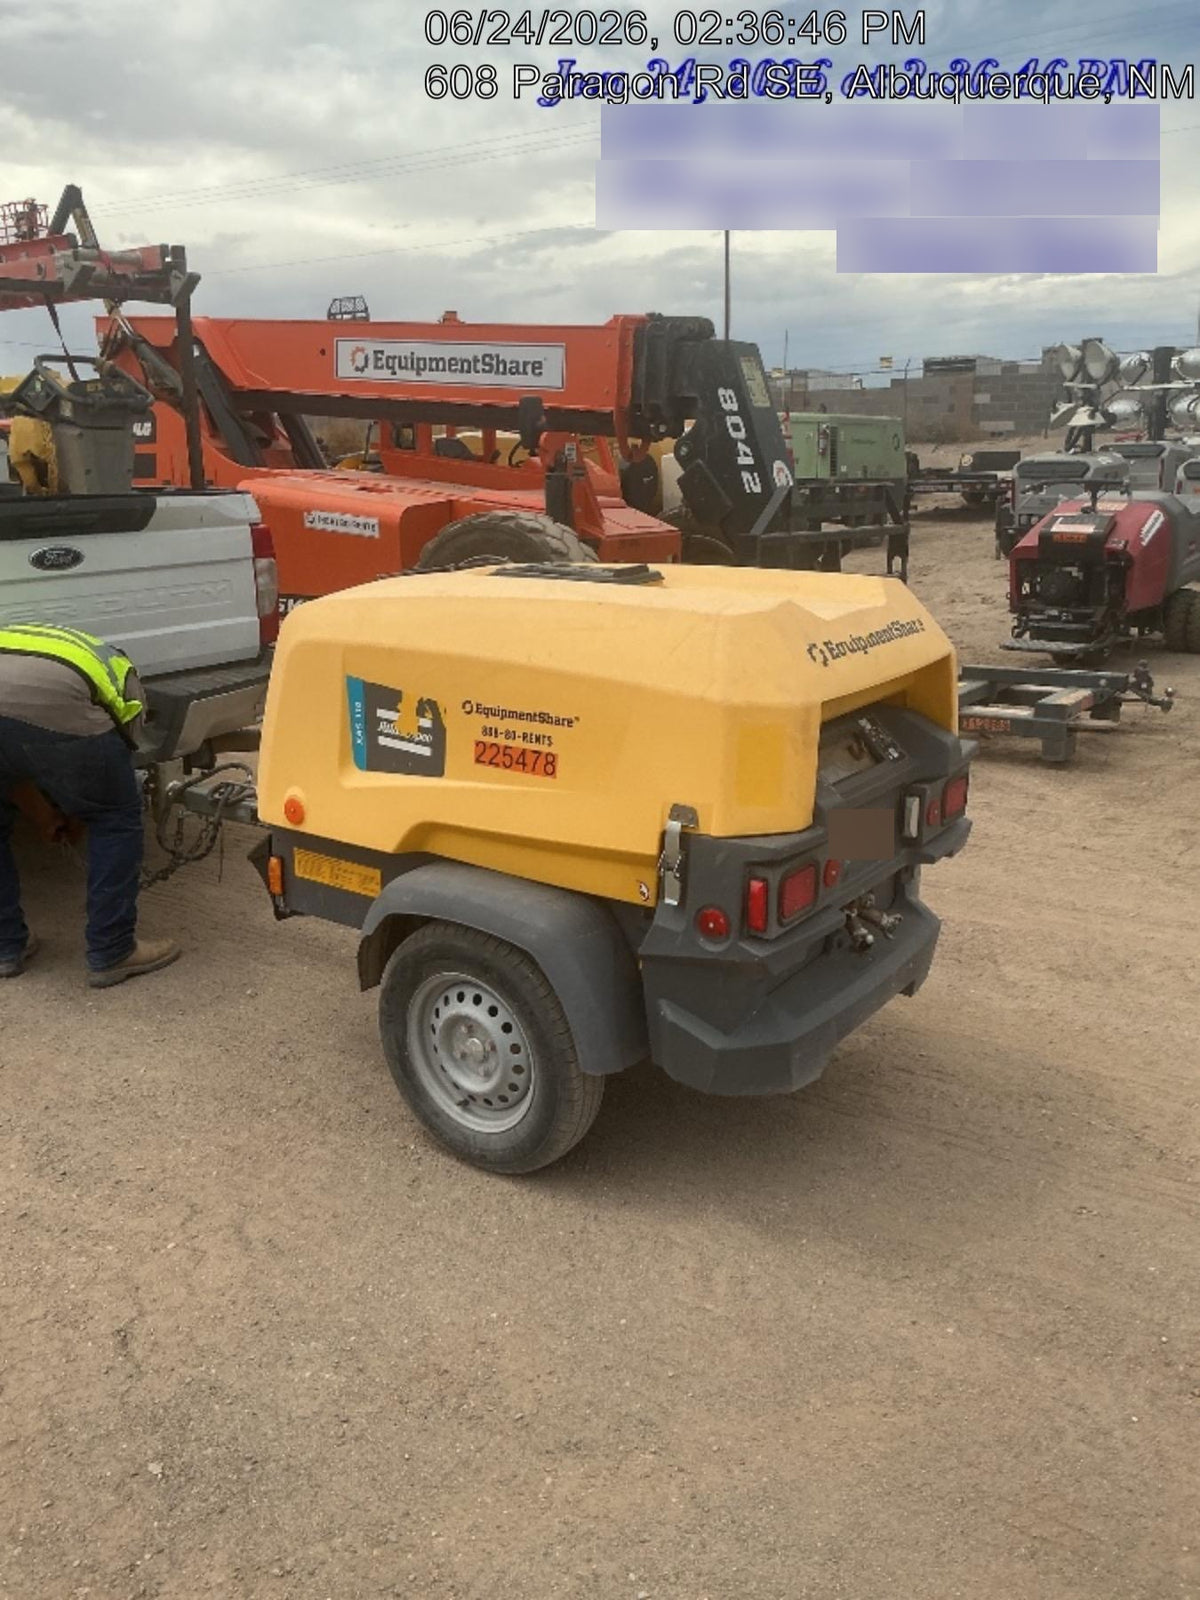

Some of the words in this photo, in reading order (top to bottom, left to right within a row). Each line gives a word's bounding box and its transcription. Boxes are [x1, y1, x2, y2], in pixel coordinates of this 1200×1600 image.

[372, 350, 544, 377] EquipmentShare
[717, 387, 762, 494] 8042
[822, 618, 926, 661] EquipmentShare
[475, 703, 575, 729] EquipmentShare
[474, 740, 556, 777] 225478
